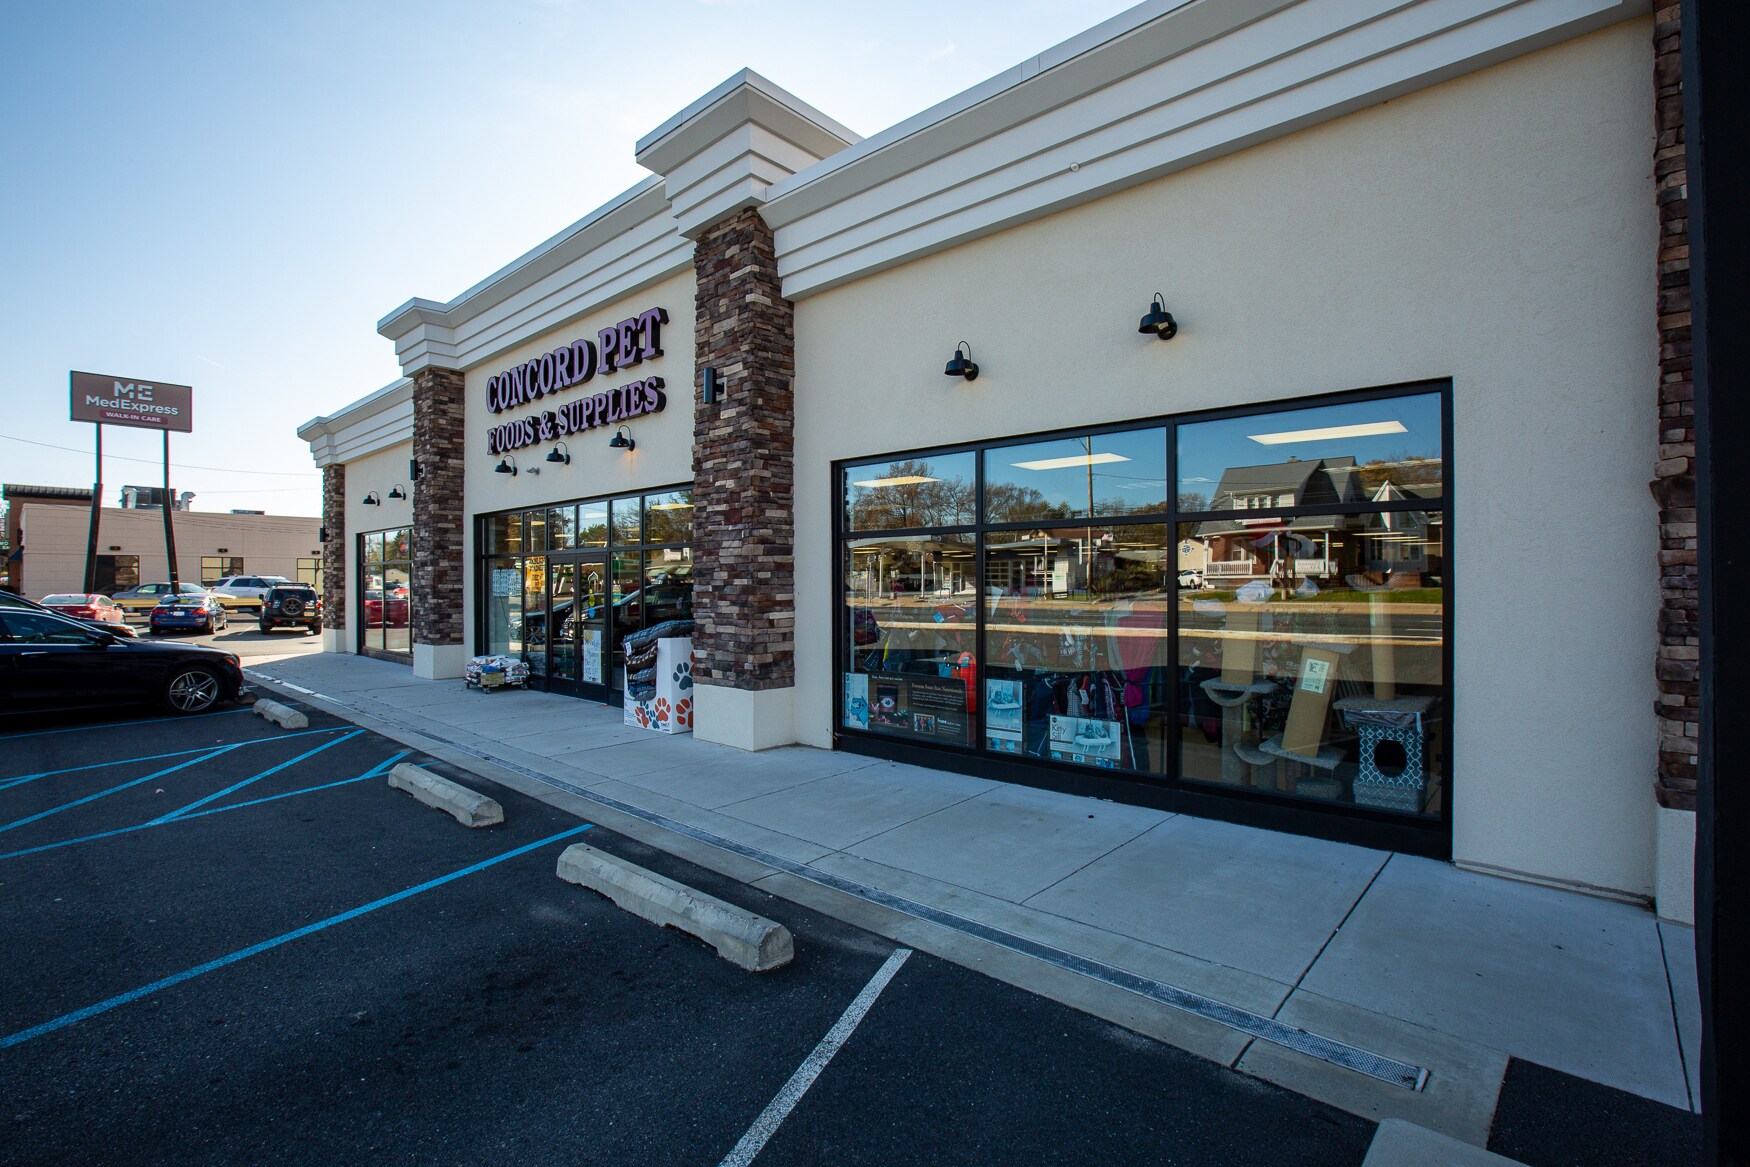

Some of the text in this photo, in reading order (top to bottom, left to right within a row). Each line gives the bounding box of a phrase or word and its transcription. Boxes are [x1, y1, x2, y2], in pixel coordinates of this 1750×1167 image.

[486, 307, 669, 414] CONCORD PET
[113, 381, 154, 402] ME
[85, 395, 179, 416] MedExpress
[106, 411, 140, 420] WALK-IN
[487, 376, 667, 455] FOODS & SUPPLIES
